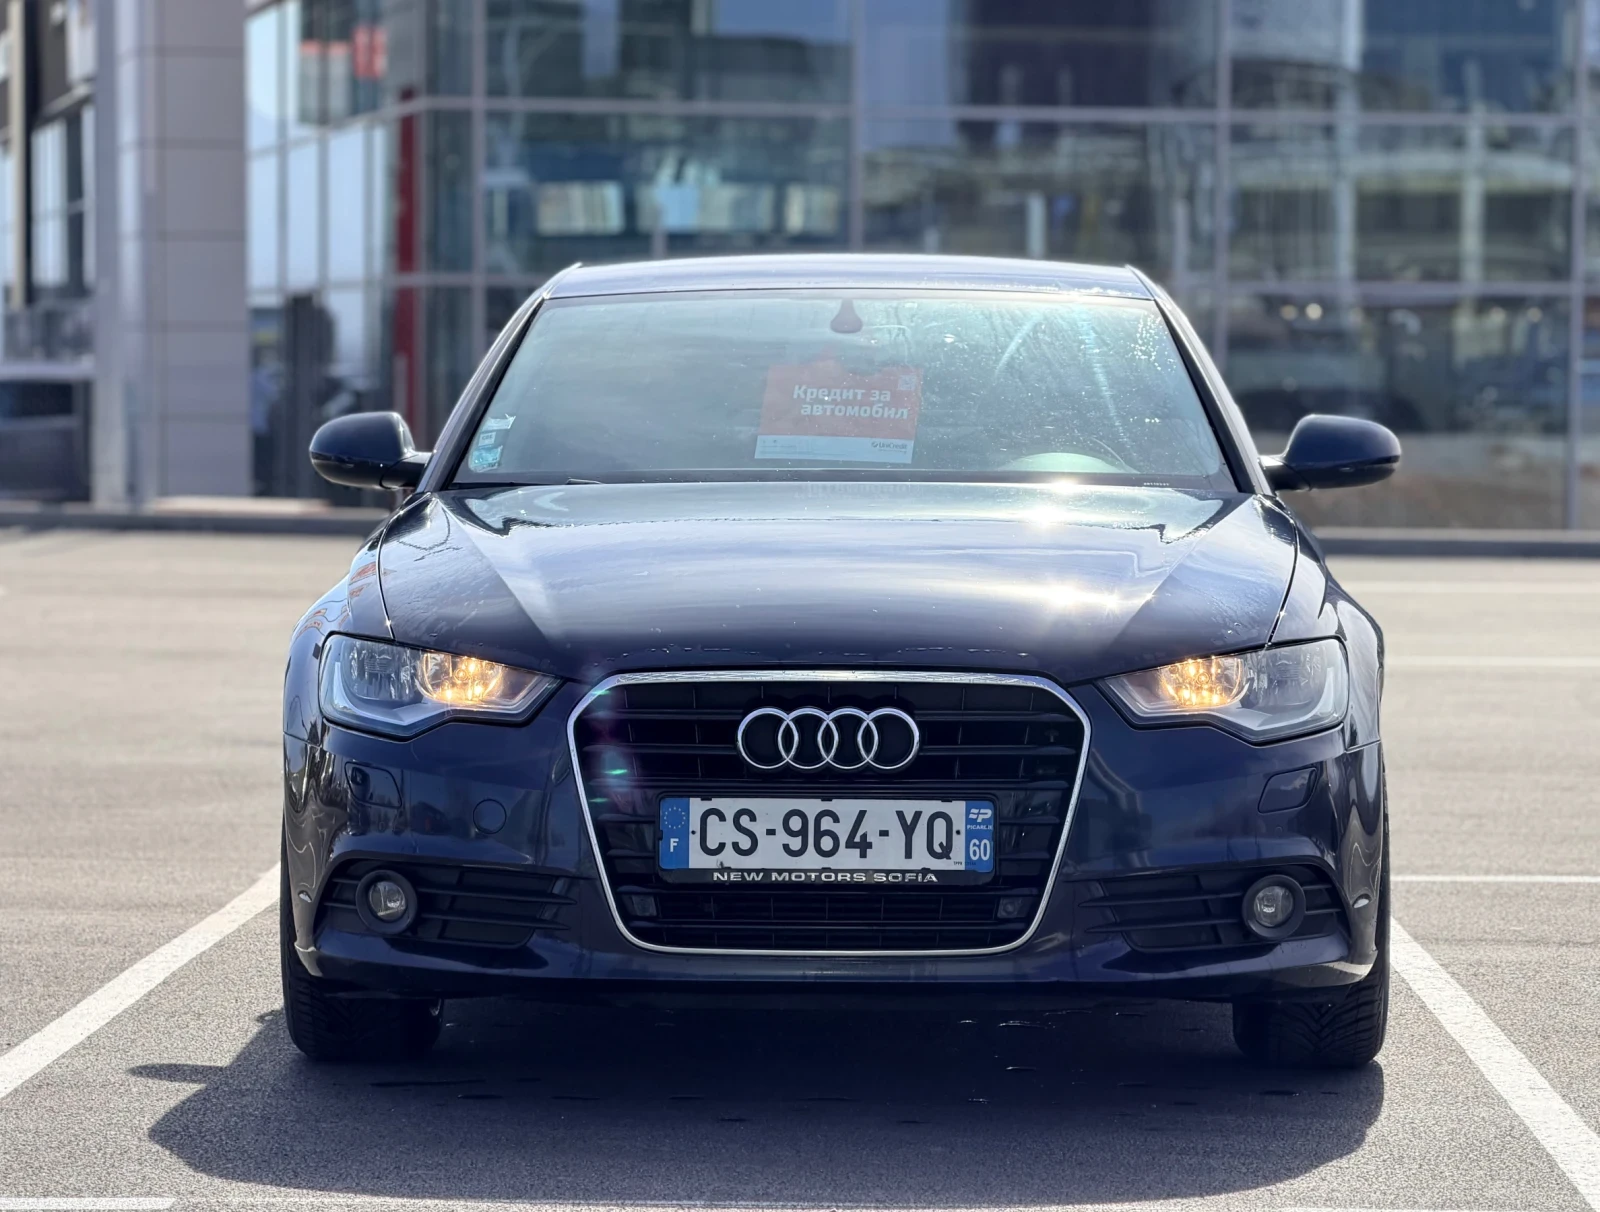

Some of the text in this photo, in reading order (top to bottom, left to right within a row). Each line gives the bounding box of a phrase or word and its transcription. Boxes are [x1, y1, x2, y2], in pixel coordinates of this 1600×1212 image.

[793, 384, 891, 402] Кредит за
[801, 402, 908, 419] автомобил
[700, 808, 953, 860] CS-964-YQ
[669, 838, 679, 852] F
[970, 838, 991, 861] 60
[712, 872, 938, 882] NEW MOTORS SOFIA
